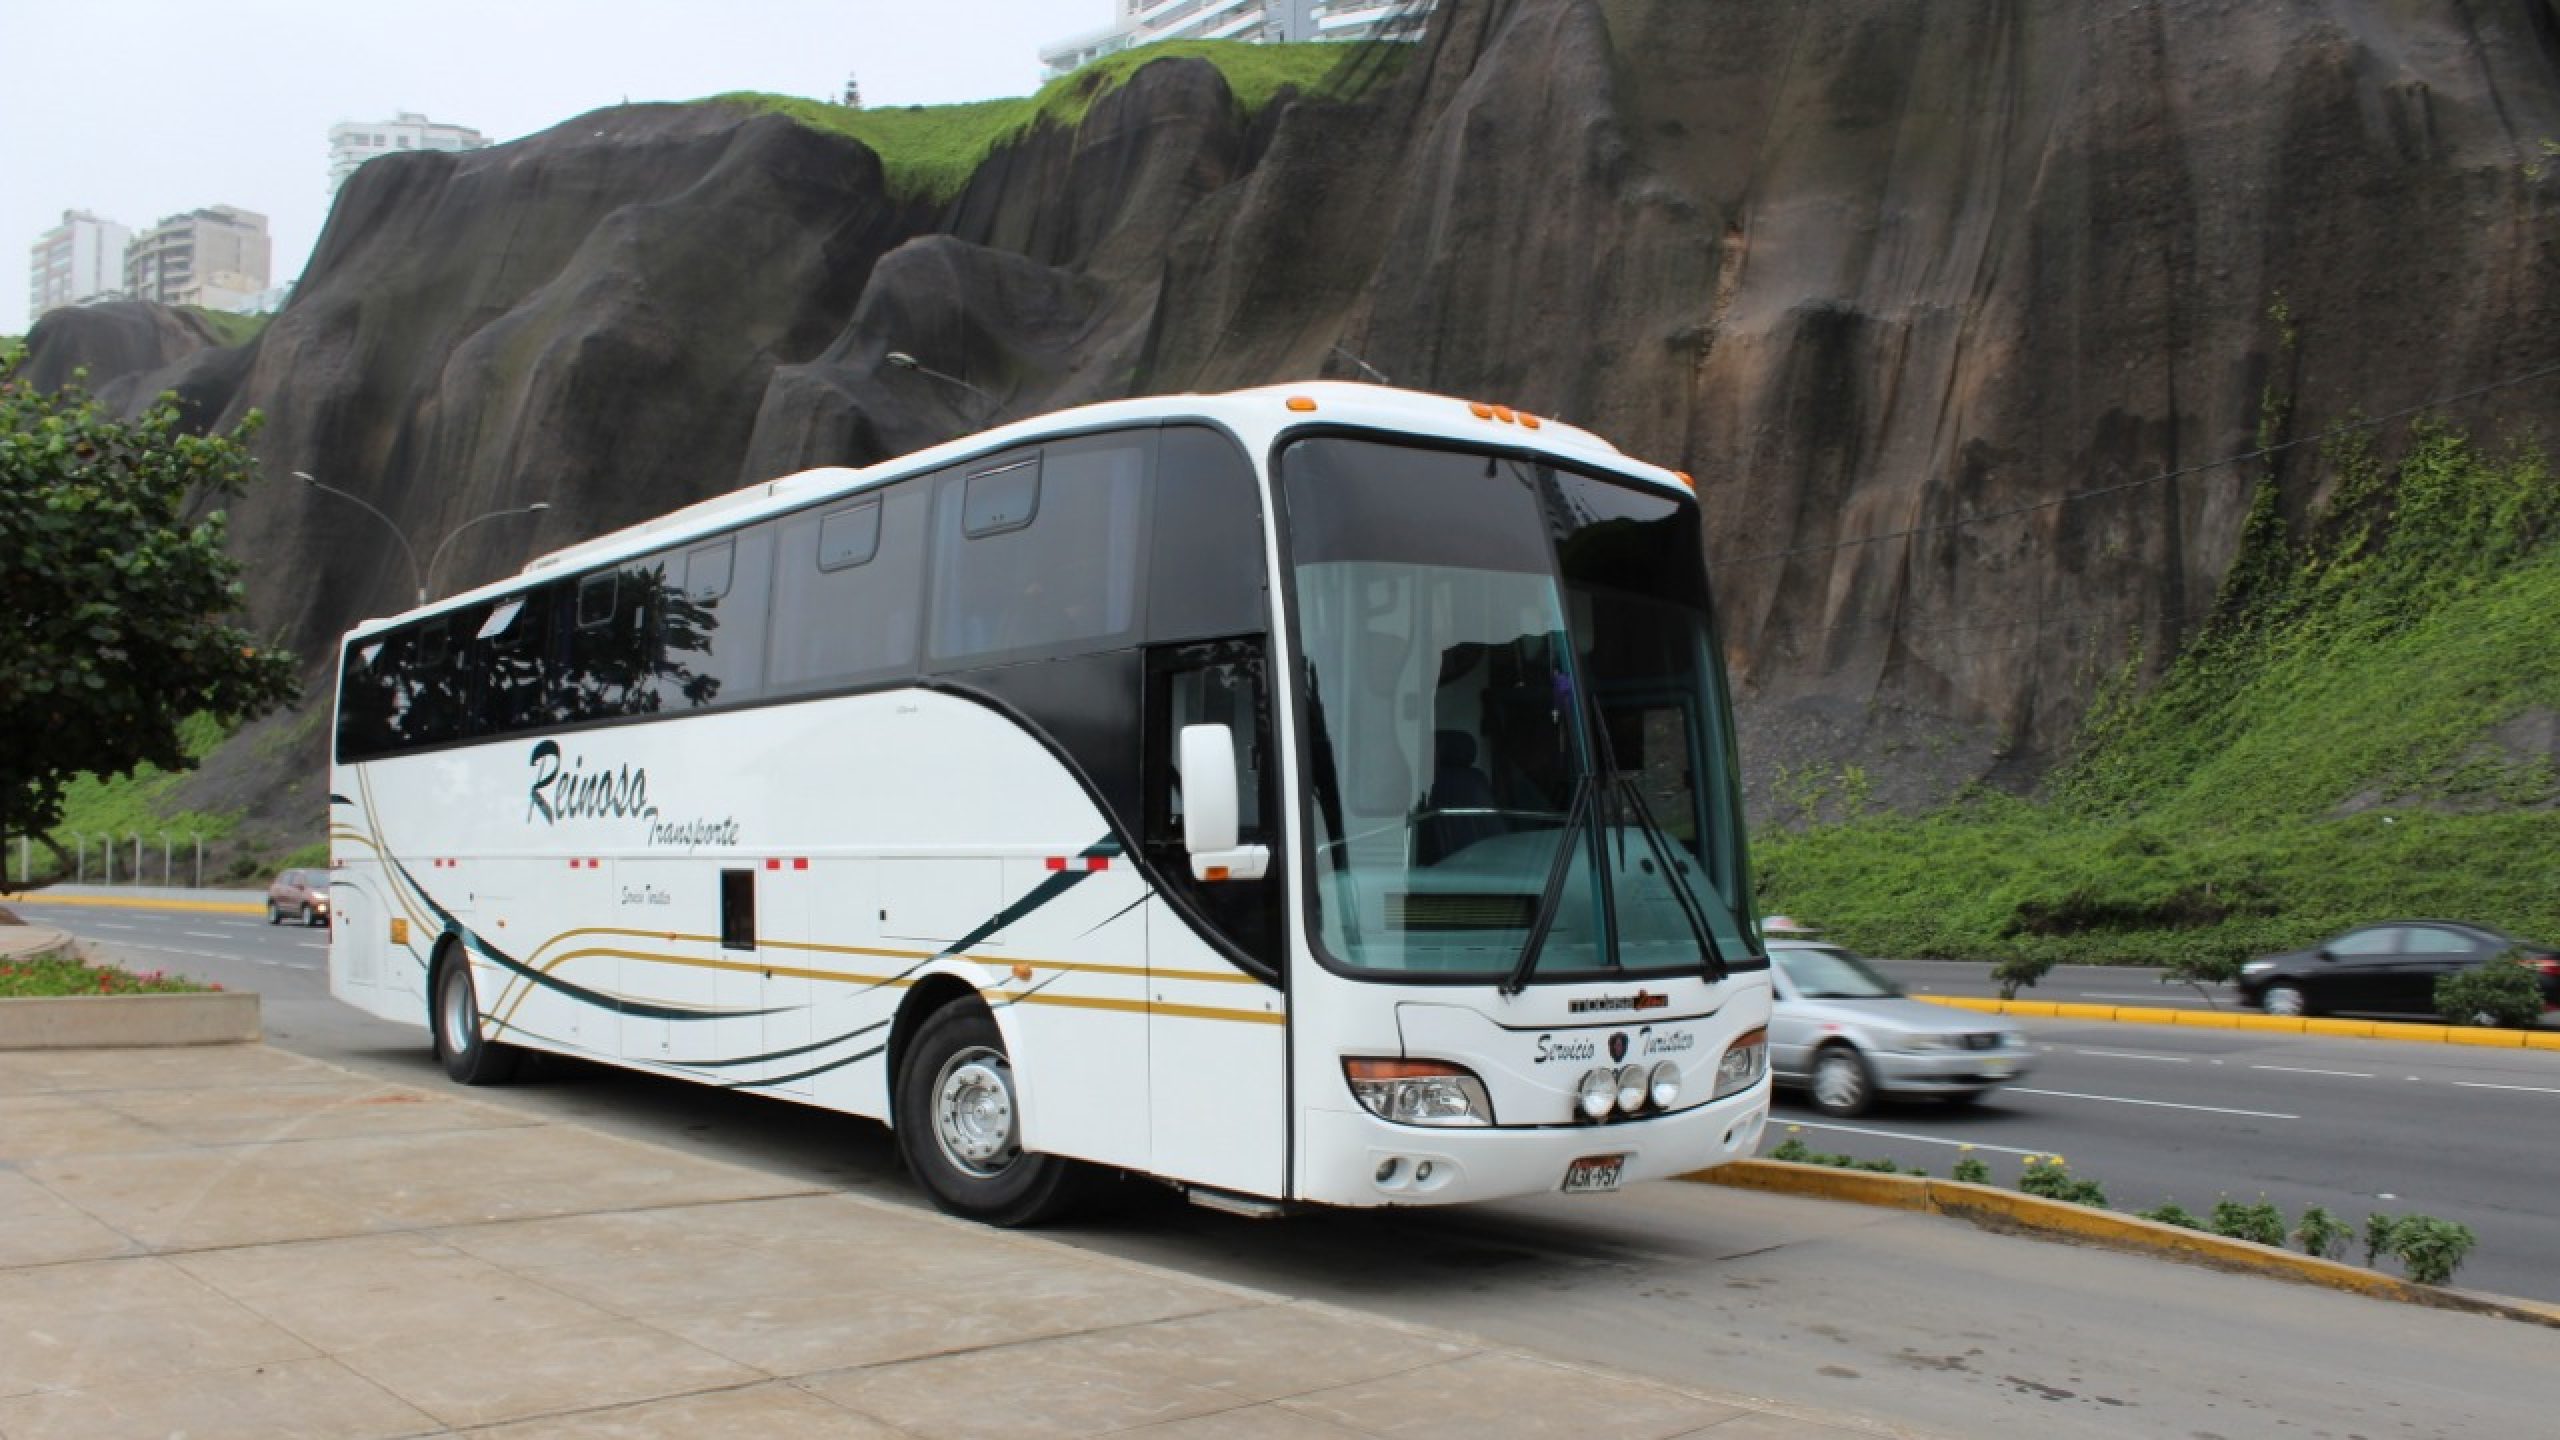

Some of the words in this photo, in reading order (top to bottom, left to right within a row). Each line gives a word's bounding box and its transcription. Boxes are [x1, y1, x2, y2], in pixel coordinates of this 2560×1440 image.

[528, 739, 647, 826] Reinoso
[643, 806, 740, 856] Transporte
[1534, 1032, 1595, 1064] Servicio
